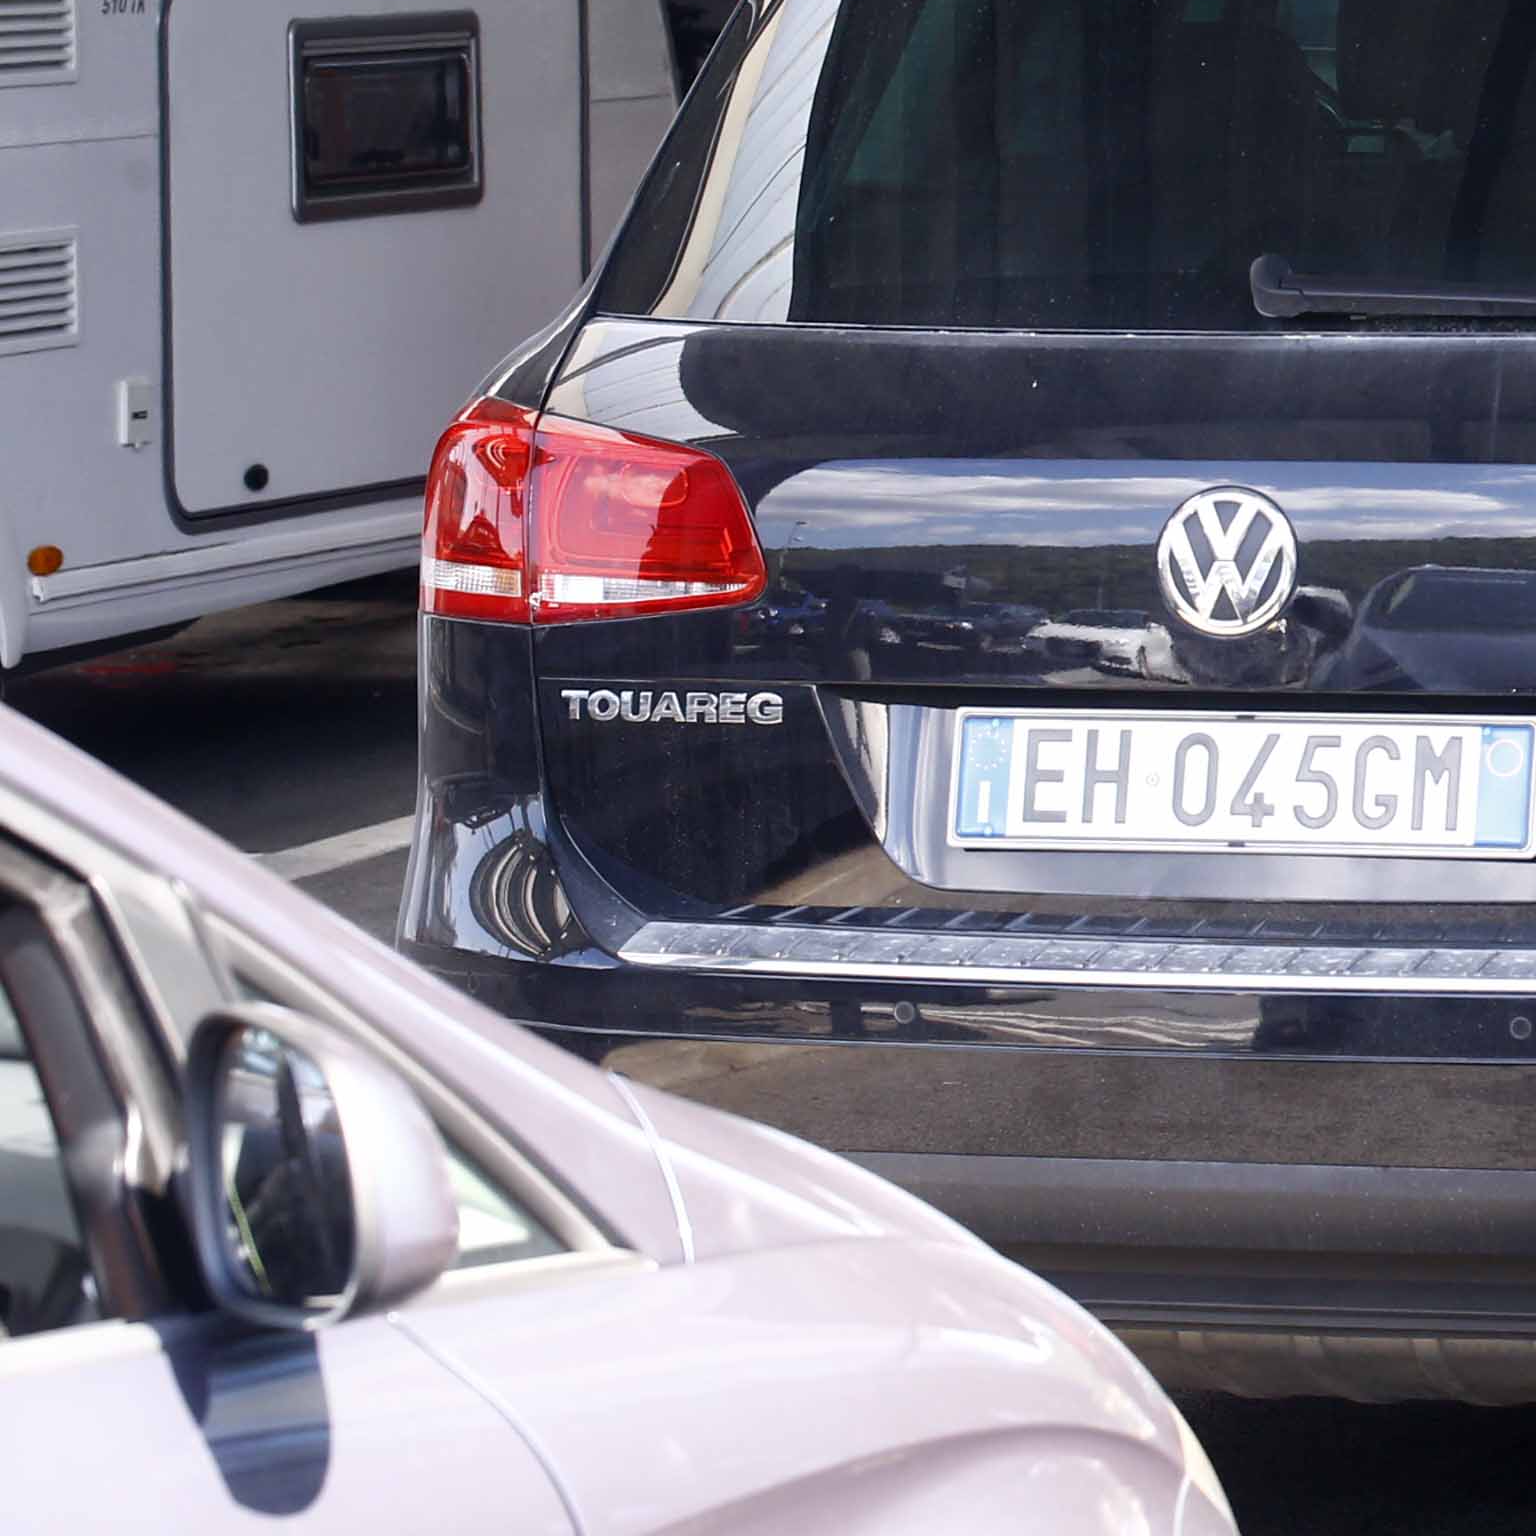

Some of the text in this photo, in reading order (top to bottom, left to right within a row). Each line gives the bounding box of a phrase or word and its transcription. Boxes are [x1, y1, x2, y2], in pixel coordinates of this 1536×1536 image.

[560, 689, 784, 725] TOUAREG
[1021, 727, 1465, 832] EH 045GM
